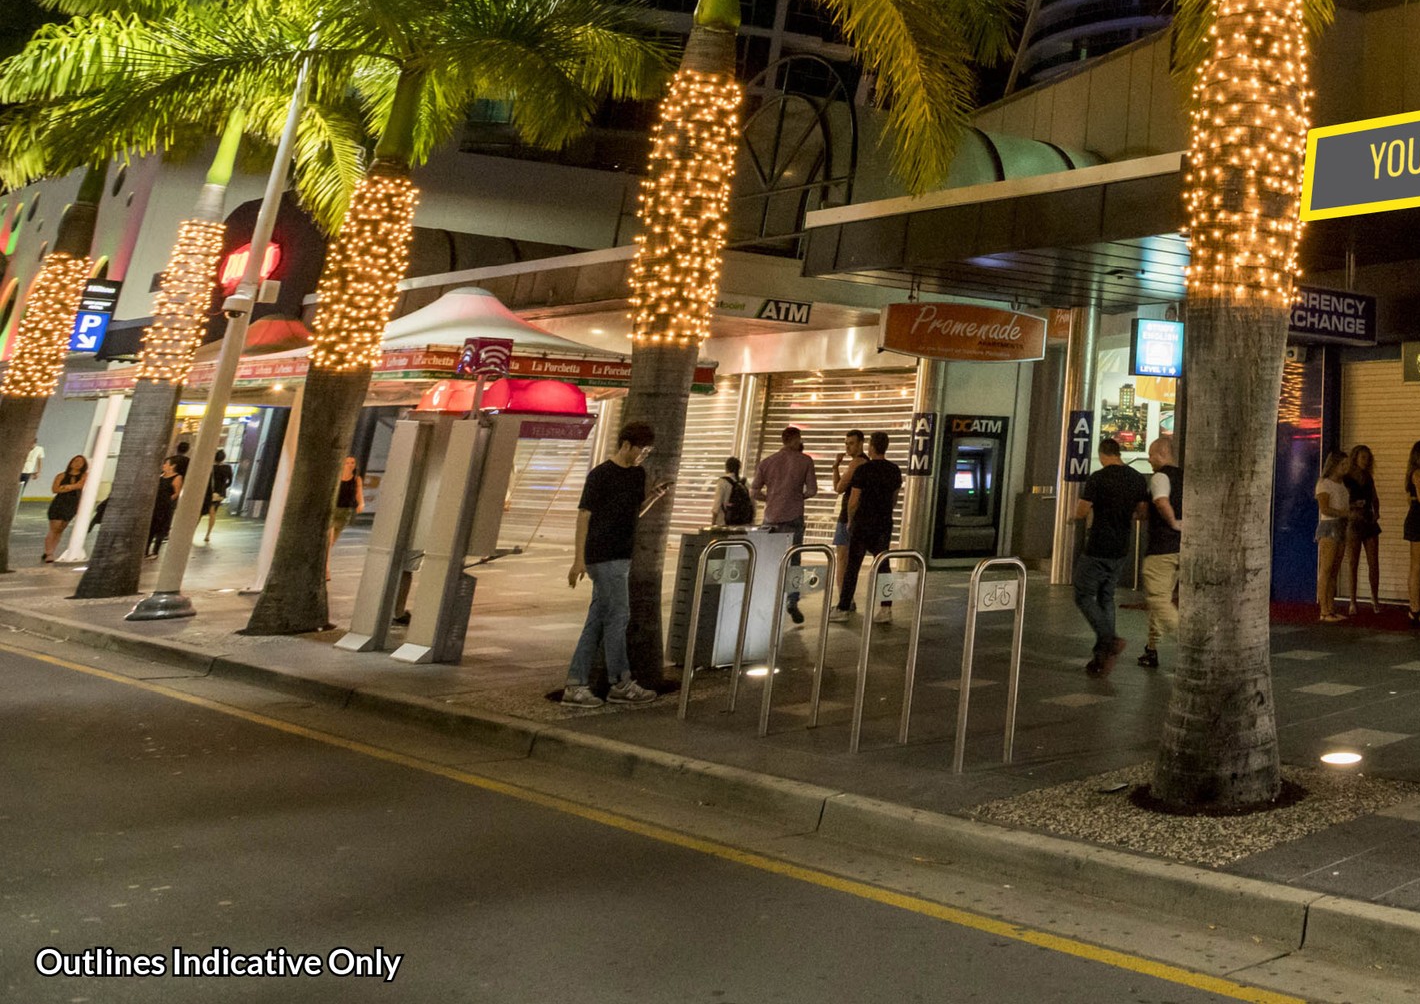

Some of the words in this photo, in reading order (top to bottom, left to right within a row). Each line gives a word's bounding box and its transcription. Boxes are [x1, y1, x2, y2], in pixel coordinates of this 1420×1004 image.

[761, 301, 809, 323] ATM
[1300, 292, 1366, 315] RRENCY
[79, 314, 102, 333] P
[910, 305, 1022, 340] Promenade
[532, 361, 543, 371] La
[544, 362, 580, 373] Porchetta
[592, 365, 602, 375] La
[603, 366, 632, 375] Porchet
[911, 417, 930, 470] ATM
[1070, 417, 1090, 475] ATM
